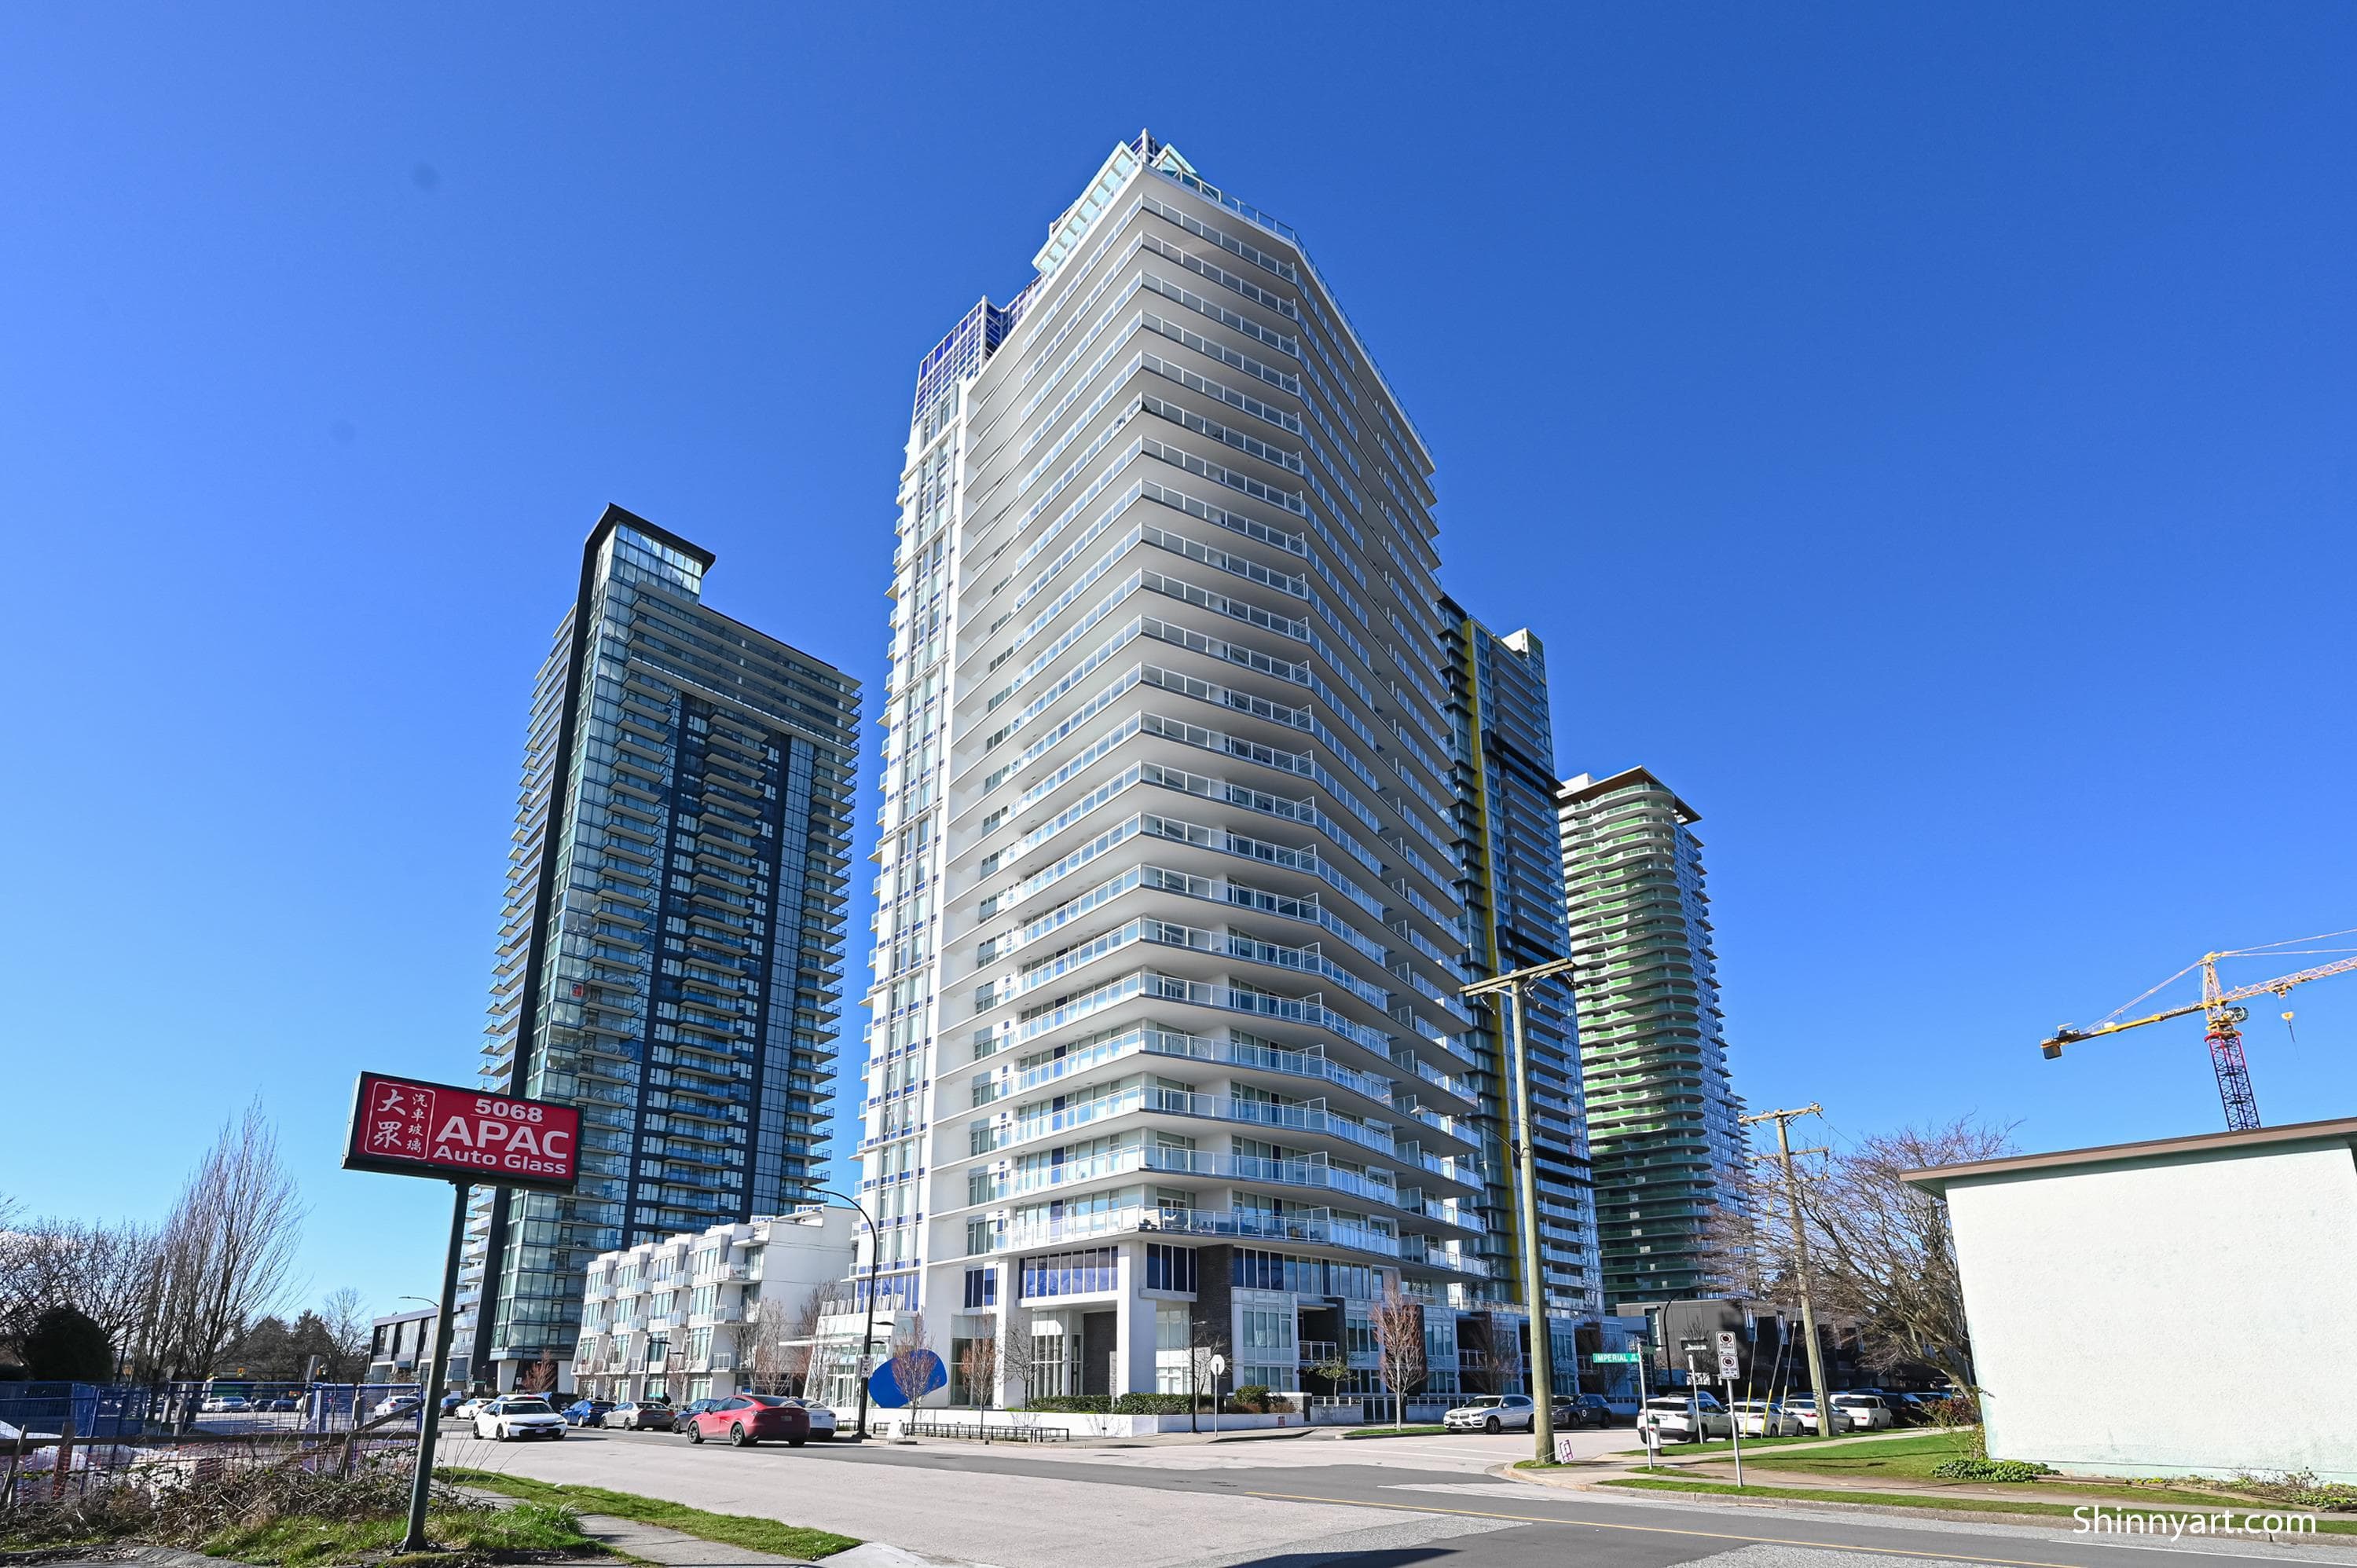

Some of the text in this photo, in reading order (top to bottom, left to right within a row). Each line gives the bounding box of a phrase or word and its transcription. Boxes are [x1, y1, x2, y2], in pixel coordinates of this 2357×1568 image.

[405, 1093, 428, 1153] 汽車玻璃
[474, 1098, 544, 1123] 5068
[434, 1116, 570, 1160] APAC
[432, 1145, 566, 1175] Auto Glass
[1595, 1354, 1628, 1363] IMPERIAL
